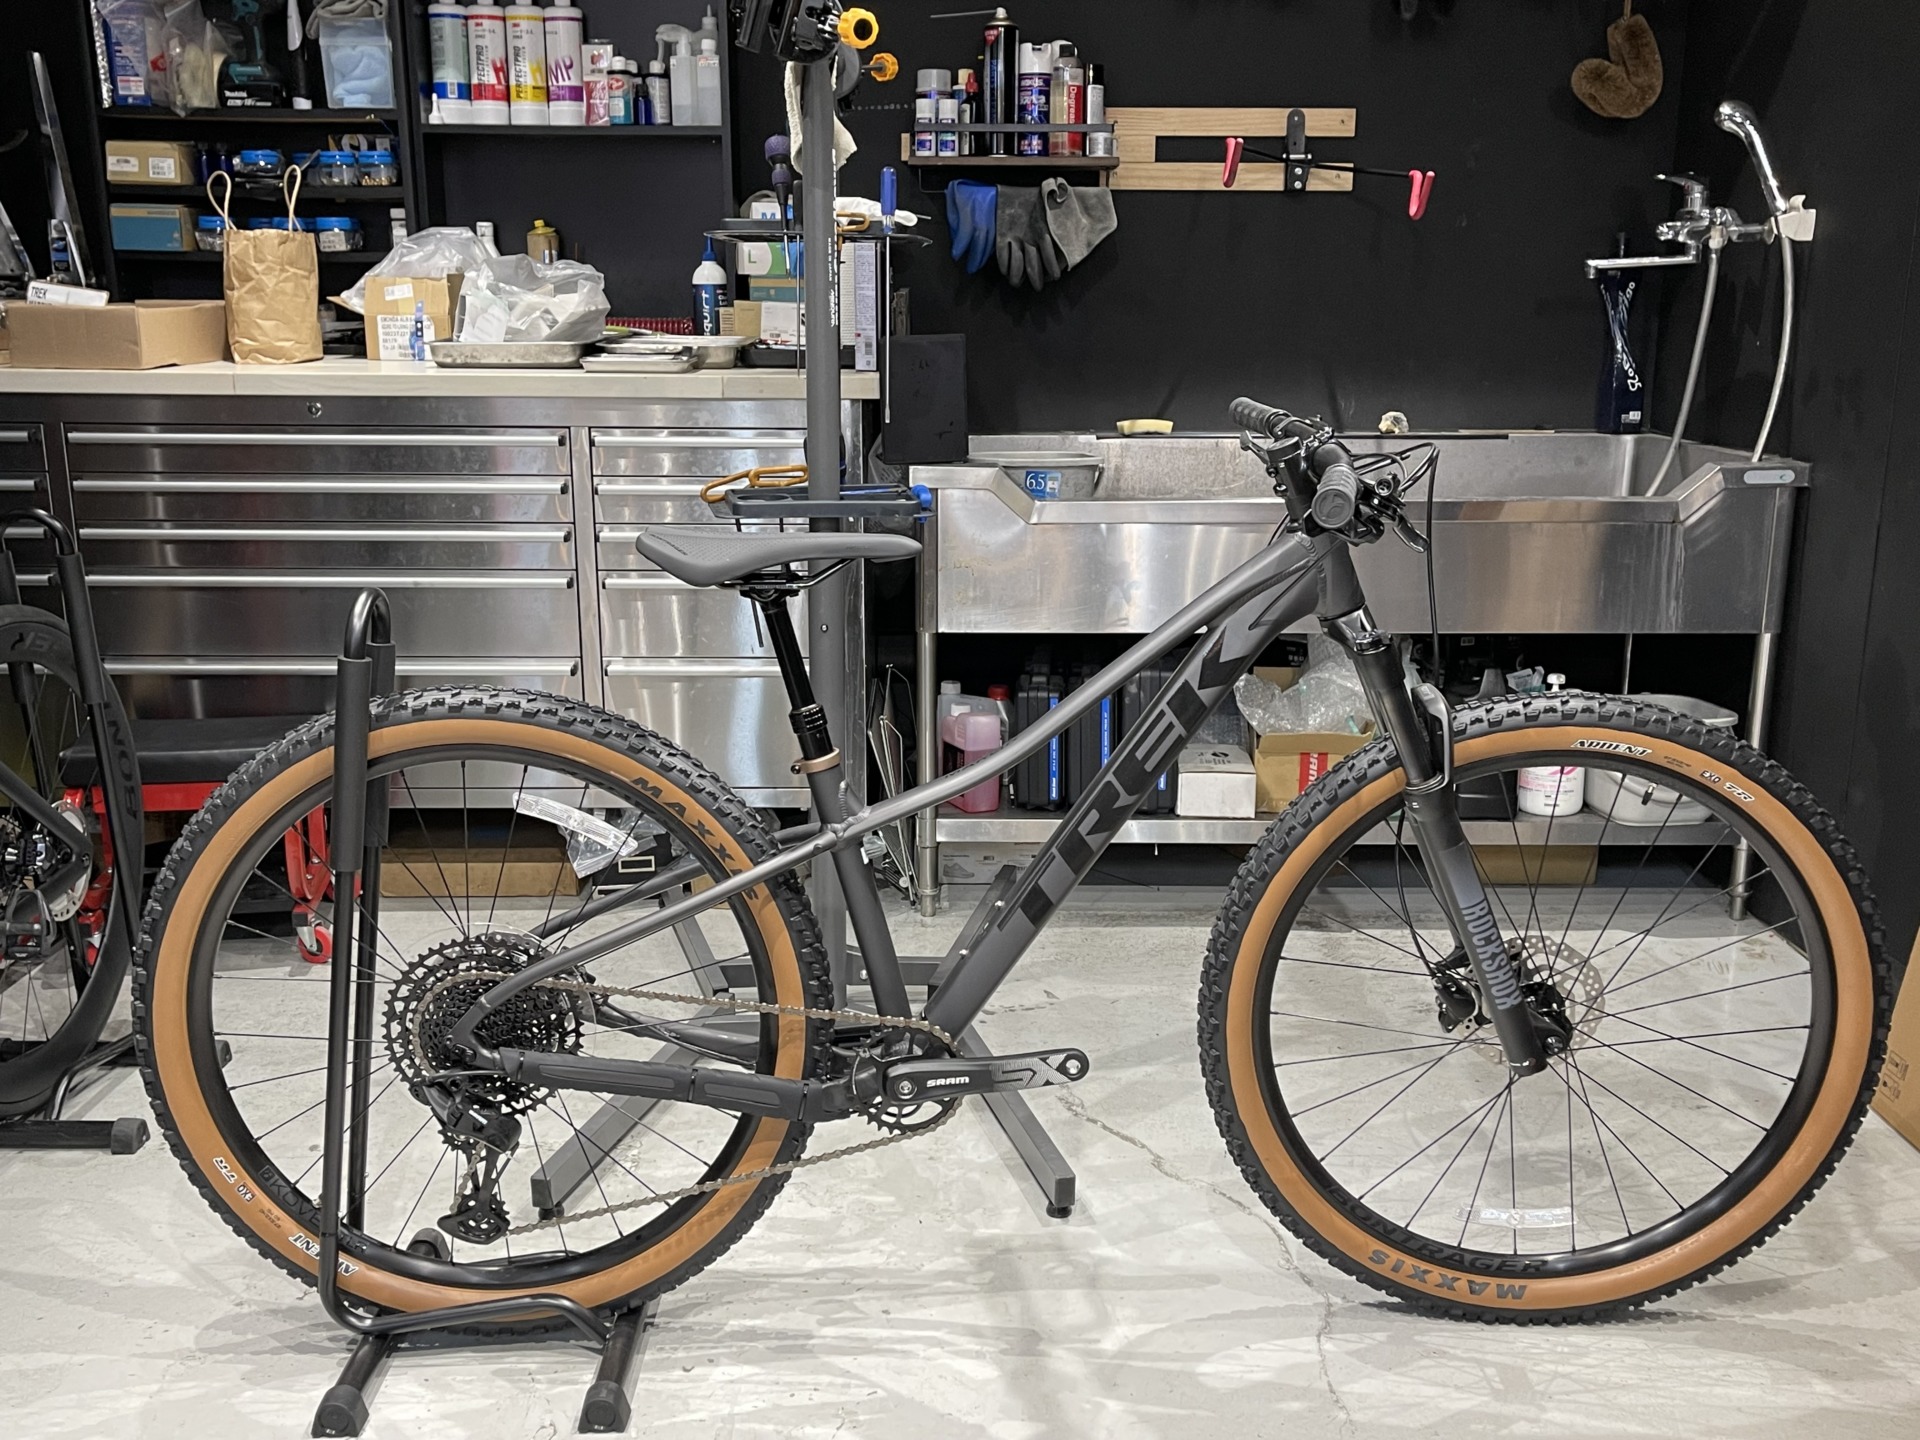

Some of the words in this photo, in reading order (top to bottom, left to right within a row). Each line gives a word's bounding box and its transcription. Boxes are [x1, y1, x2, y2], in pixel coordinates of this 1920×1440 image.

[748, 249, 757, 263] L
[31, 286, 48, 300] TREK
[999, 626, 1251, 931] TREK
[1700, 769, 1722, 784] EXO
[1723, 782, 1754, 803] TR
[1461, 901, 1522, 1011] ROCKSHOX
[926, 1076, 970, 1088] SRAM
[212, 1156, 238, 1184] TR
[236, 1181, 256, 1204] EXO
[268, 1177, 321, 1228] KOVE
[1329, 1187, 1549, 1273] BONTRAGER
[288, 1232, 359, 1277] AENT
[1367, 1249, 1528, 1301] MAXXIS
